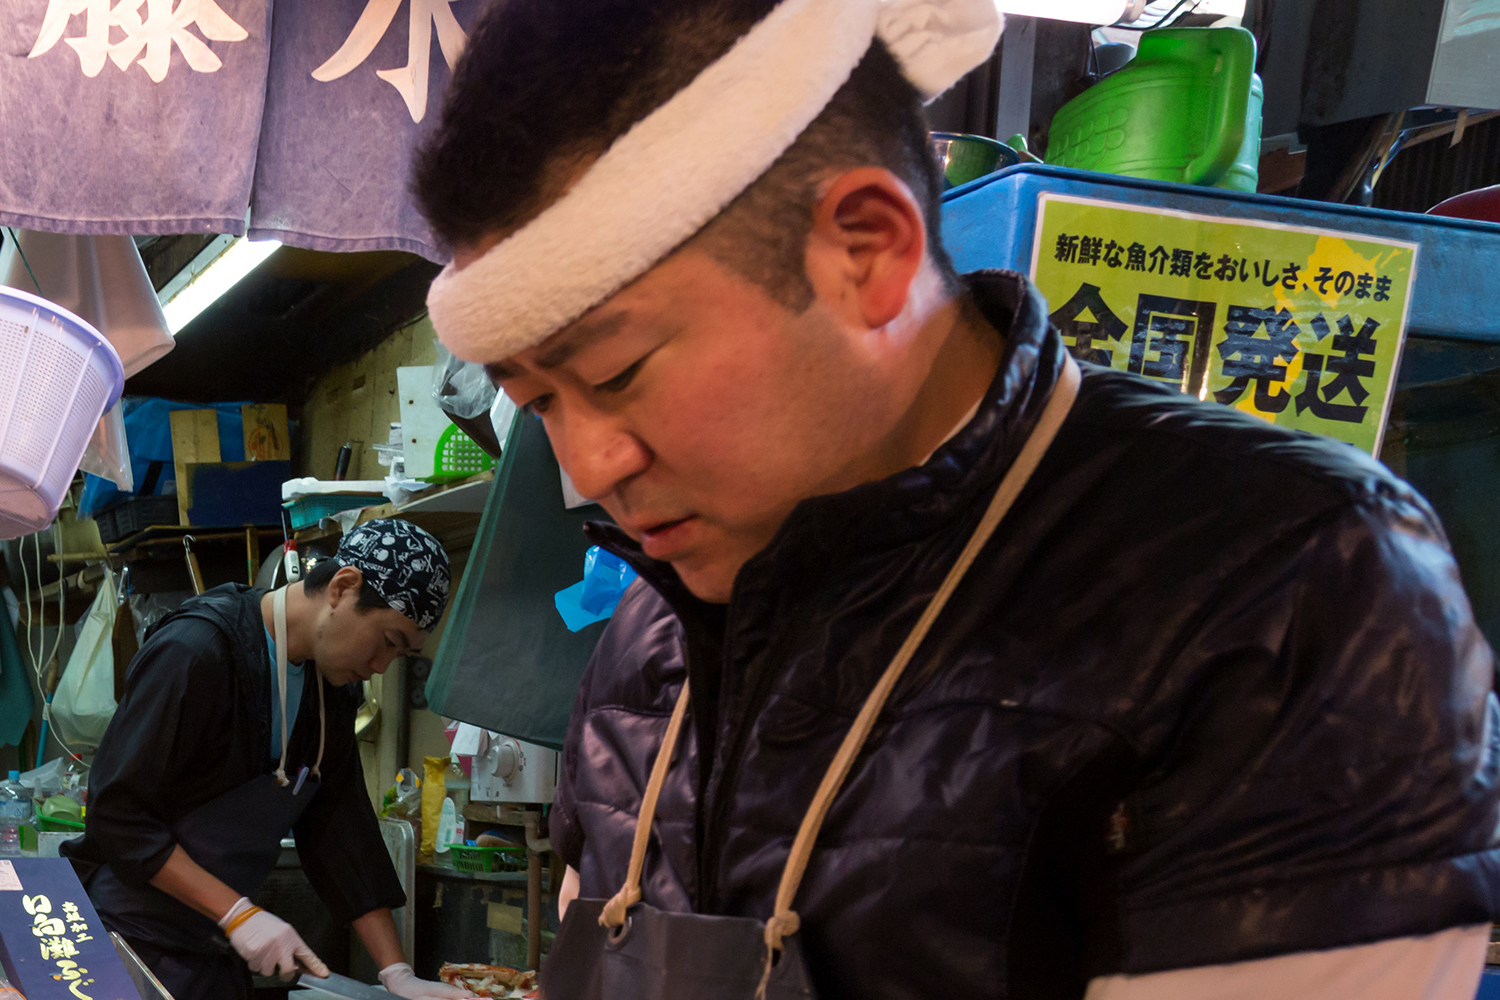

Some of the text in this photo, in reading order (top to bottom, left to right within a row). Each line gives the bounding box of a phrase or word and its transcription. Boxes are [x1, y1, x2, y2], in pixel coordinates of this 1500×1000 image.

[1054, 233, 1393, 302] 新鮮な魚介類をおいしさ、そのまま
[1050, 283, 1381, 424] 全国発送
